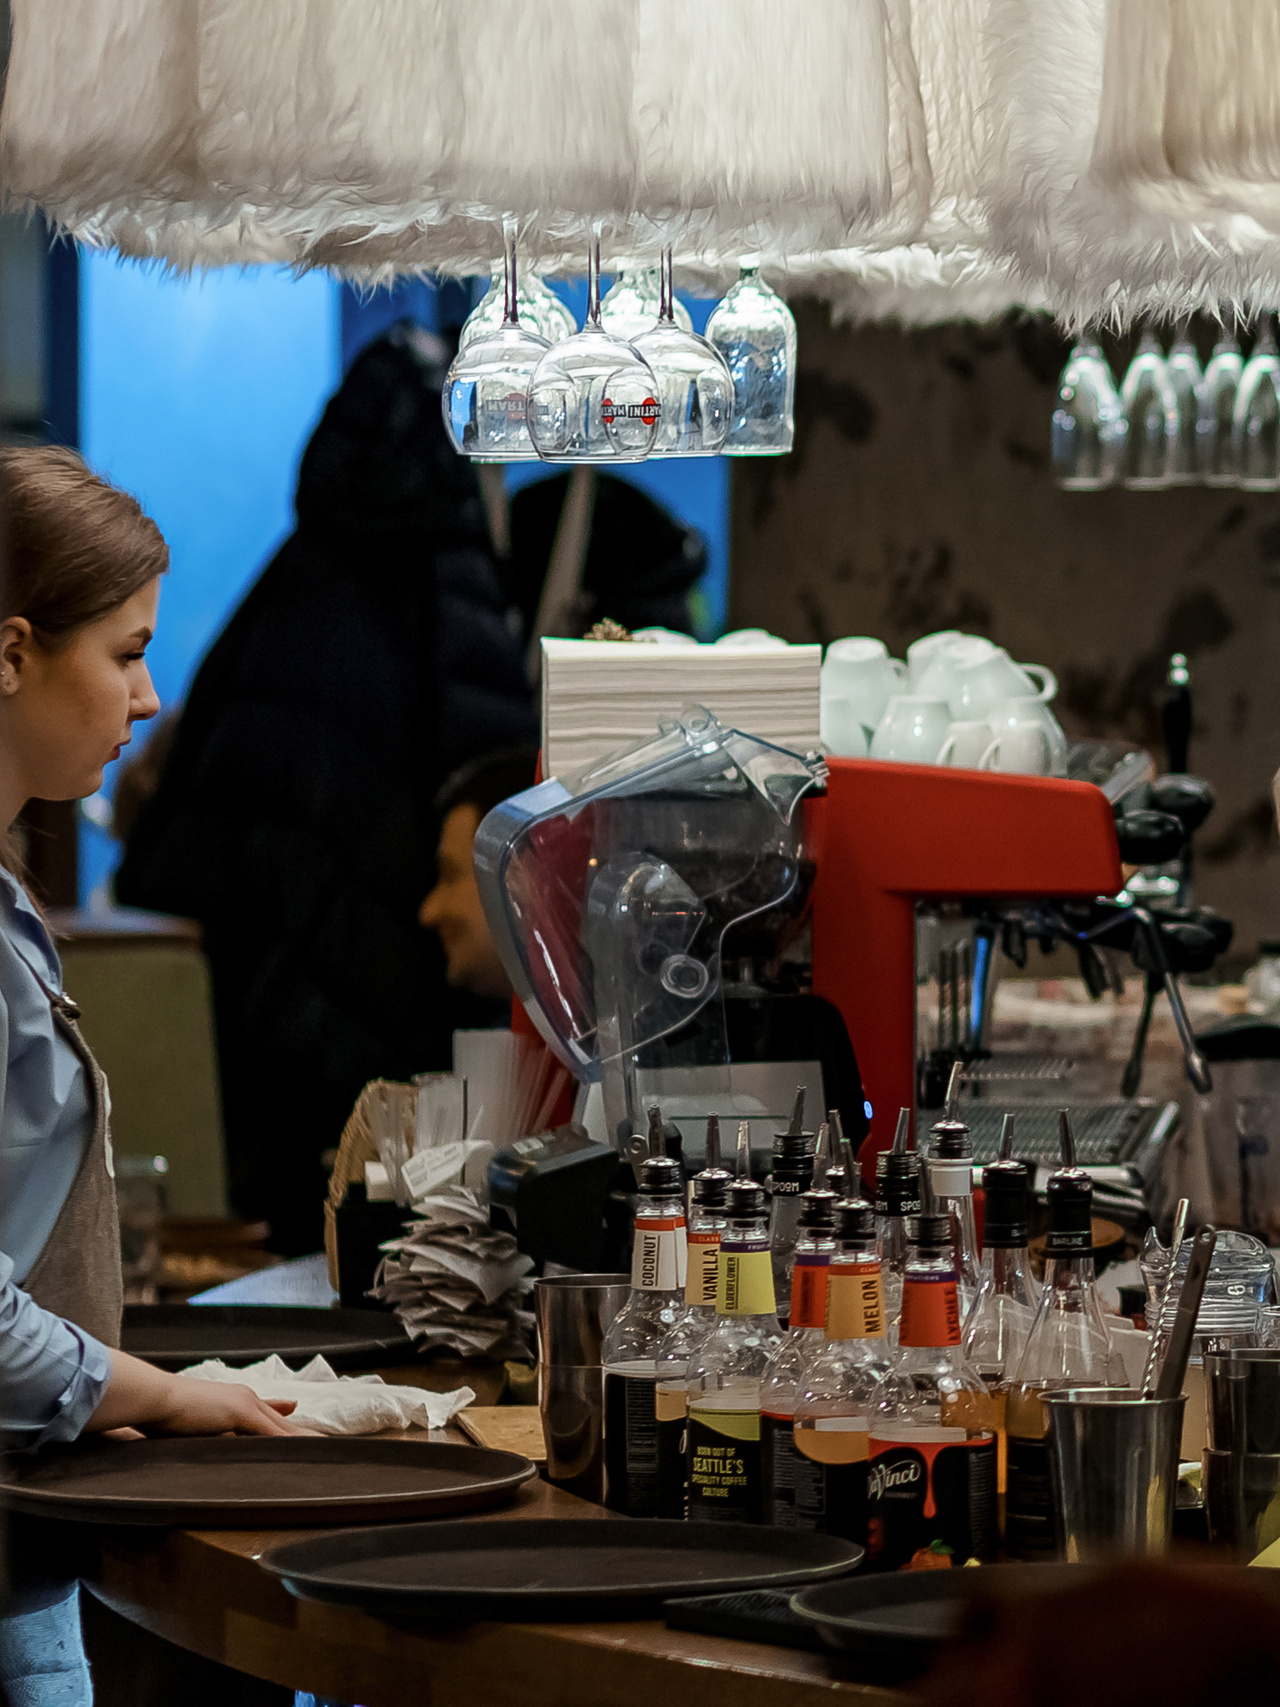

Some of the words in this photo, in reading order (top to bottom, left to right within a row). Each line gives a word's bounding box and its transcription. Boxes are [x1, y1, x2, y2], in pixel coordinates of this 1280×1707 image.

[772, 1181, 799, 1192] POOM
[642, 1235, 656, 1287] COCONUT
[703, 1248, 719, 1301] VANILLA
[725, 1257, 737, 1311] ELDERFLOWER
[861, 1279, 881, 1333] MELON
[693, 1456, 744, 1474] SEATTLE'S
[721, 1476, 748, 1486] COFFEE
